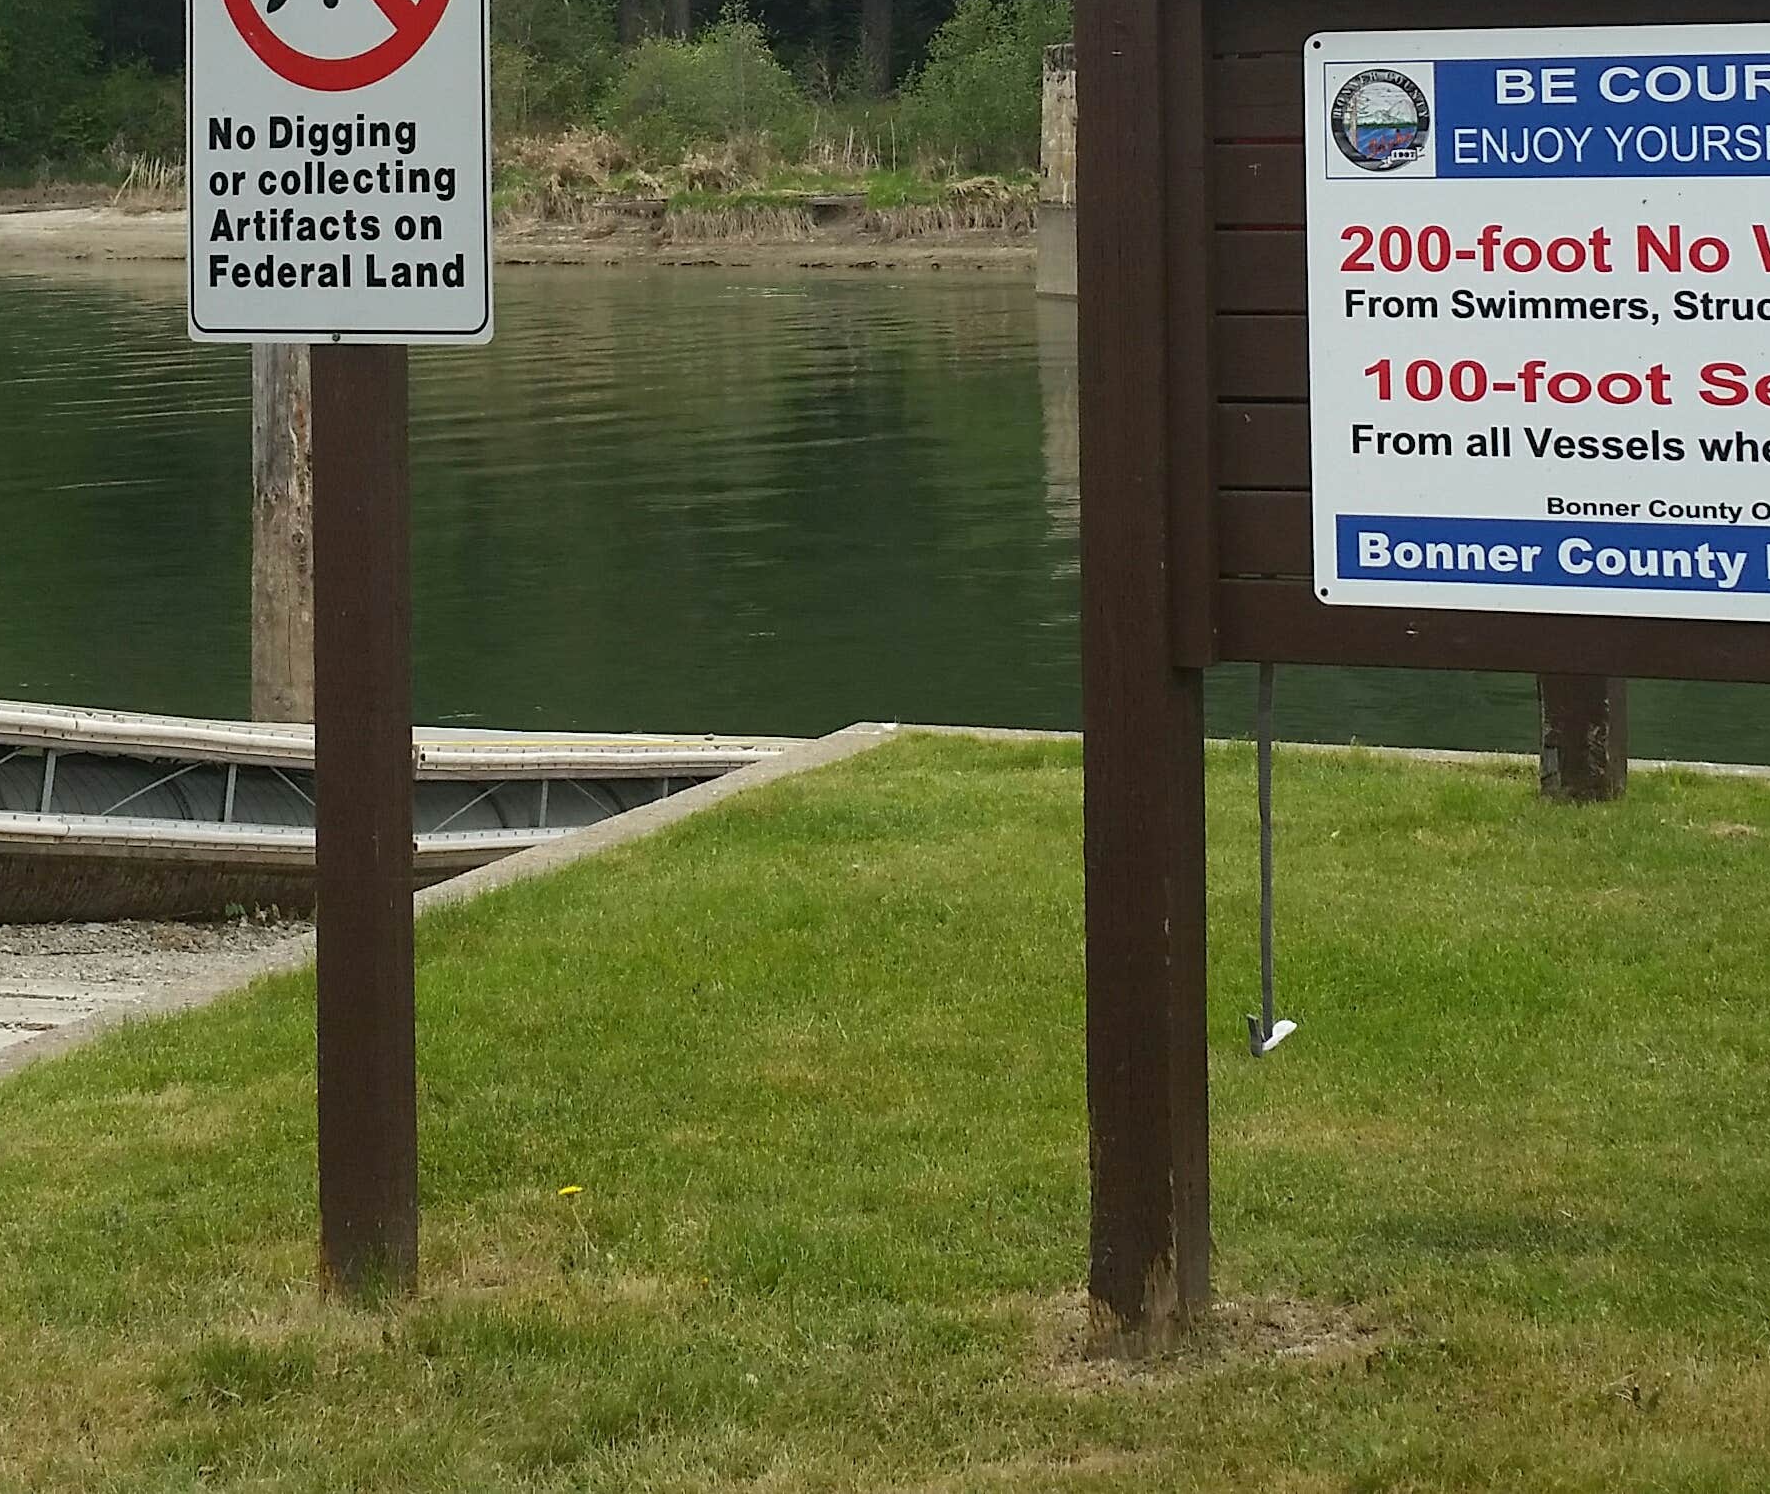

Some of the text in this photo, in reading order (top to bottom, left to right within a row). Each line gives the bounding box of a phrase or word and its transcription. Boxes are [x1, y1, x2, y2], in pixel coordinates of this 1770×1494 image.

[1495, 68, 1577, 106] BE
[208, 114, 417, 156] No Digging
[1453, 127, 1592, 165] ENJOY
[209, 160, 456, 201] or collecting
[209, 209, 442, 241] Artifacts on
[1339, 223, 1614, 274] 200-foot
[1636, 223, 1731, 273] No
[209, 254, 464, 287] Federal Land
[1346, 289, 1439, 320] From
[1451, 288, 1661, 325] Swimmers,
[1364, 358, 1672, 407] 100-foot
[1351, 424, 1452, 458] From
[1465, 425, 1511, 458] all
[1523, 427, 1685, 463] Vessels
[1546, 497, 1641, 517] Bonner
[1649, 499, 1742, 524] County
[1357, 532, 1542, 573] Bonner
[1558, 539, 1746, 585] County
